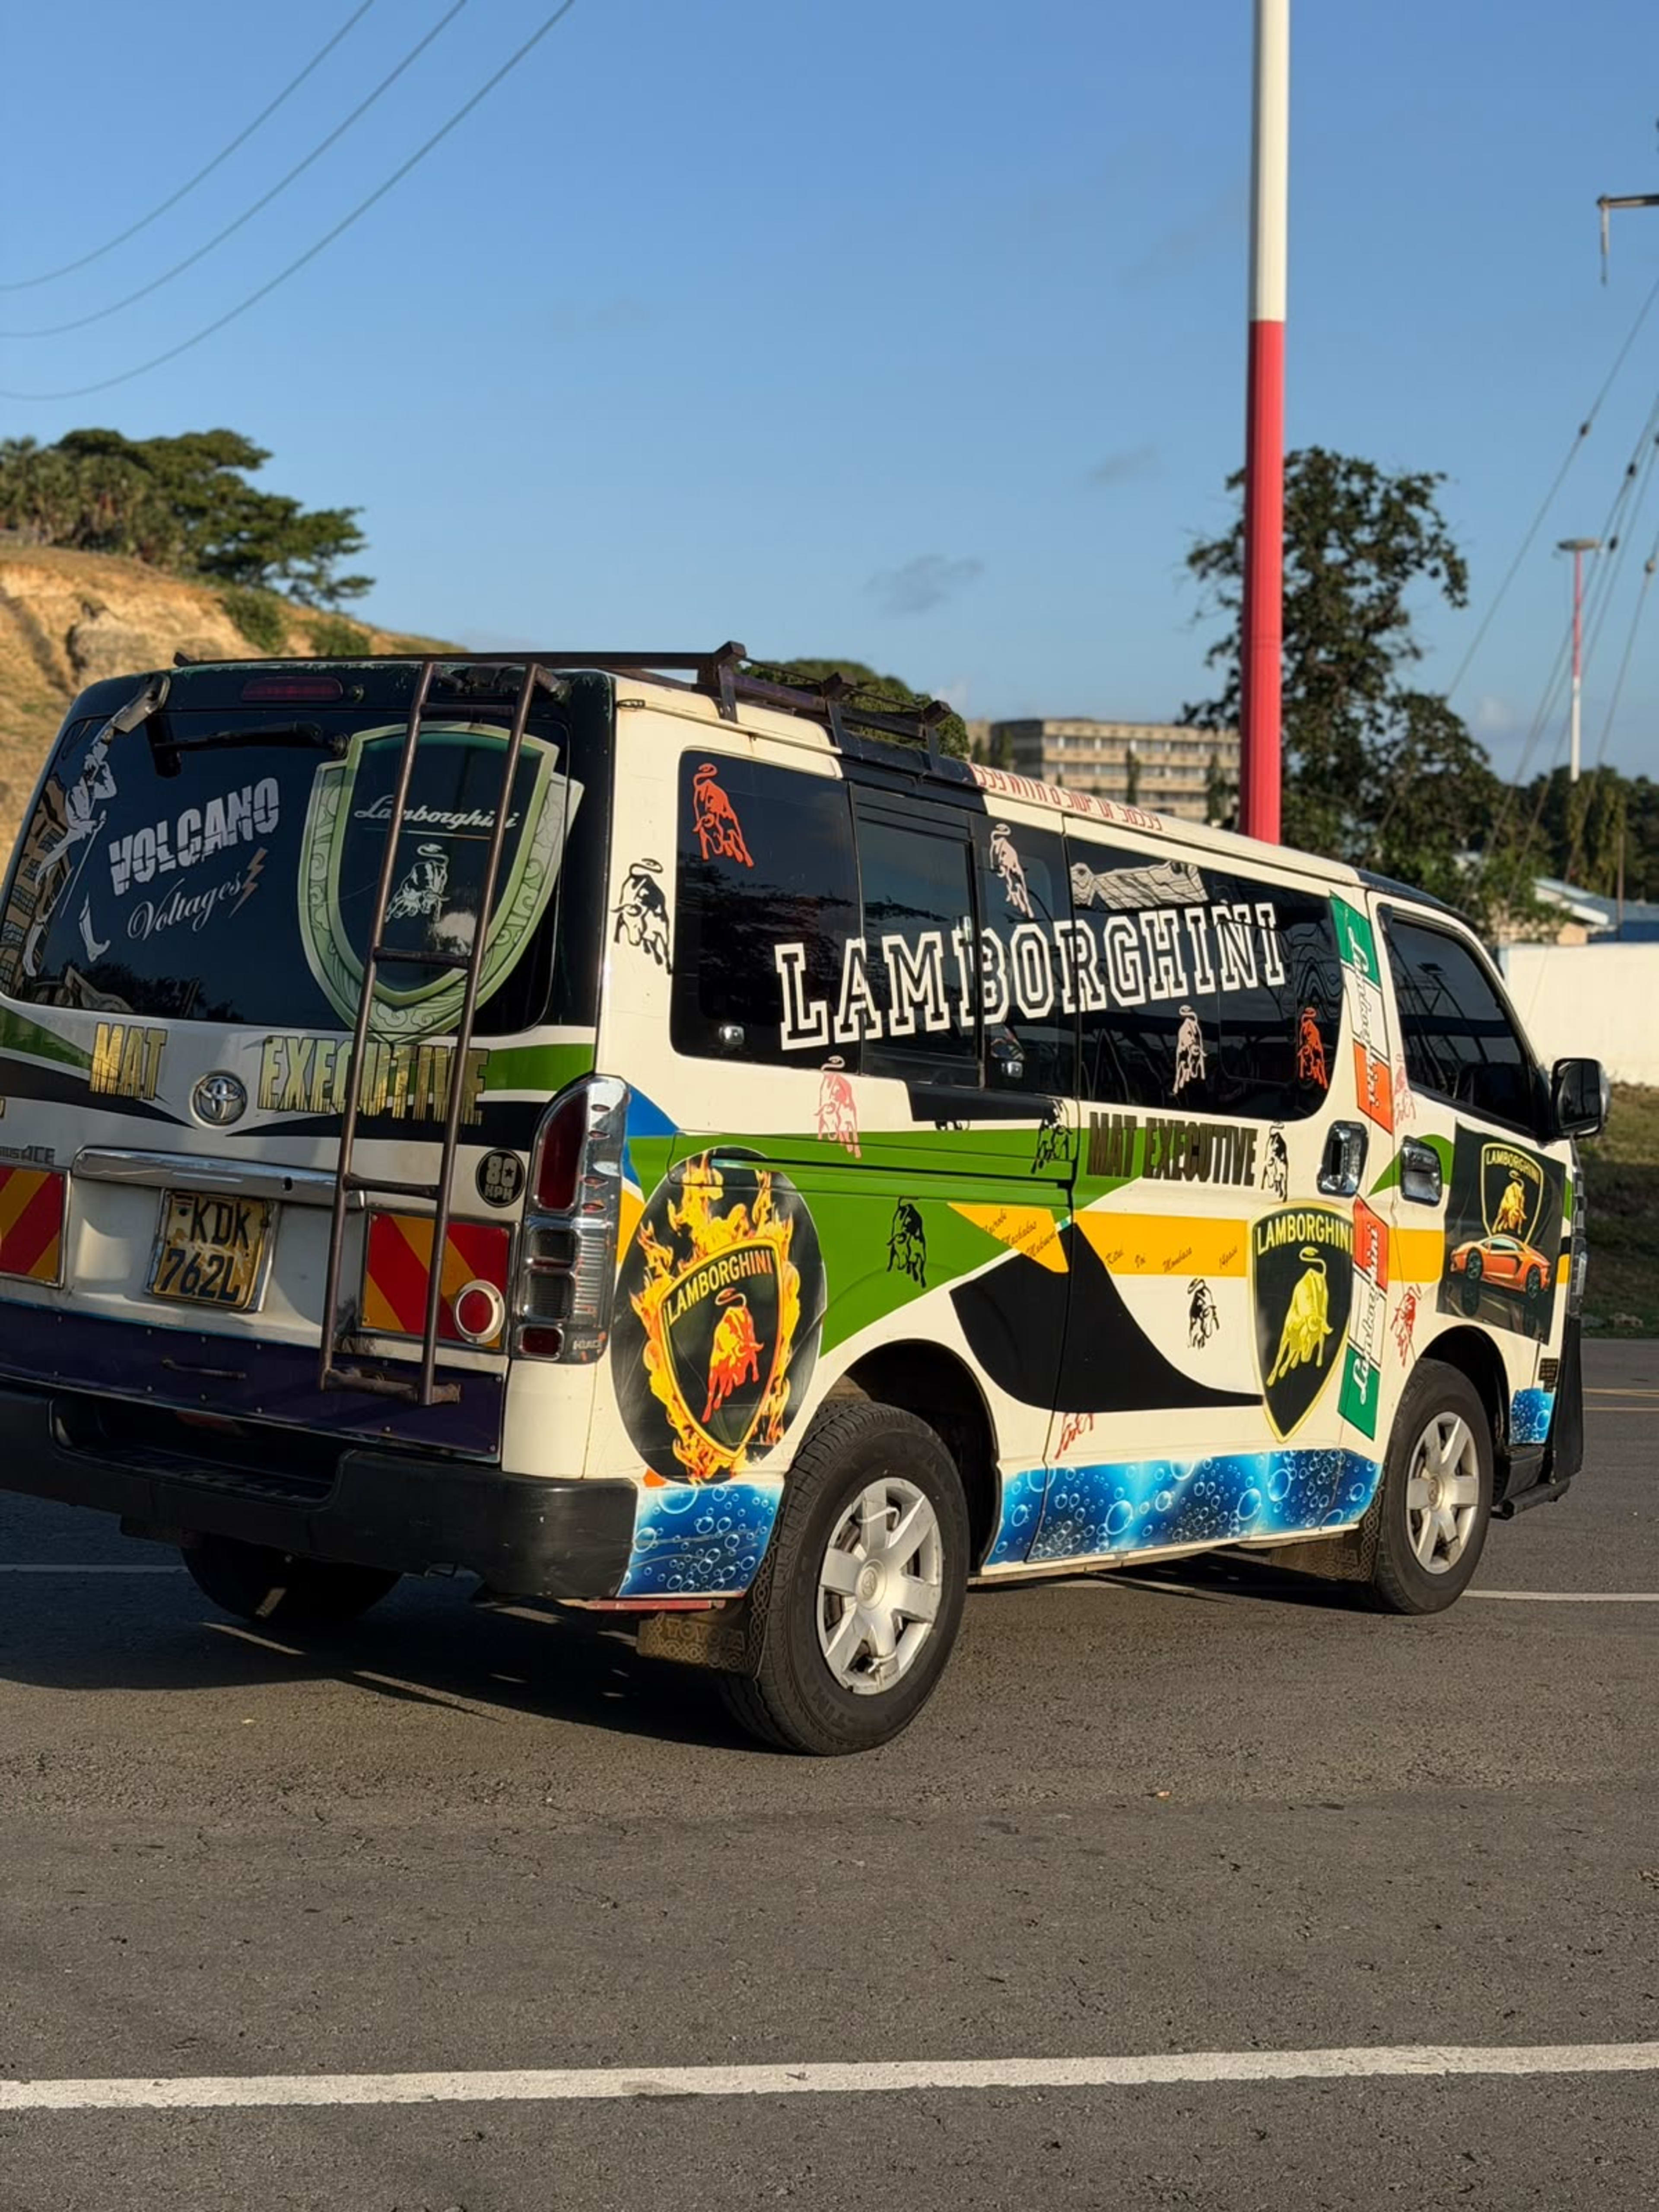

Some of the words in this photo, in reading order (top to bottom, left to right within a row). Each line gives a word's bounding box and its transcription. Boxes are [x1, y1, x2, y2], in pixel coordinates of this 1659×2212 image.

[108, 777, 280, 896] VOLCANO
[127, 871, 241, 941] Voltages
[774, 903, 1286, 1051] LAMBORGHINI
[89, 1021, 168, 1101] MAT
[486, 1155, 518, 1188] 80
[1086, 1111, 1137, 1178] MAT
[1142, 1117, 1258, 1186] EXECUTIVE
[1486, 1150, 1539, 1185] LAMBORGHINI
[189, 1195, 251, 1250] KDK
[1257, 1213, 1354, 1256] LAMBORGHINI
[159, 1247, 241, 1302] 762L
[667, 1249, 774, 1327] LAMBORGHINI
